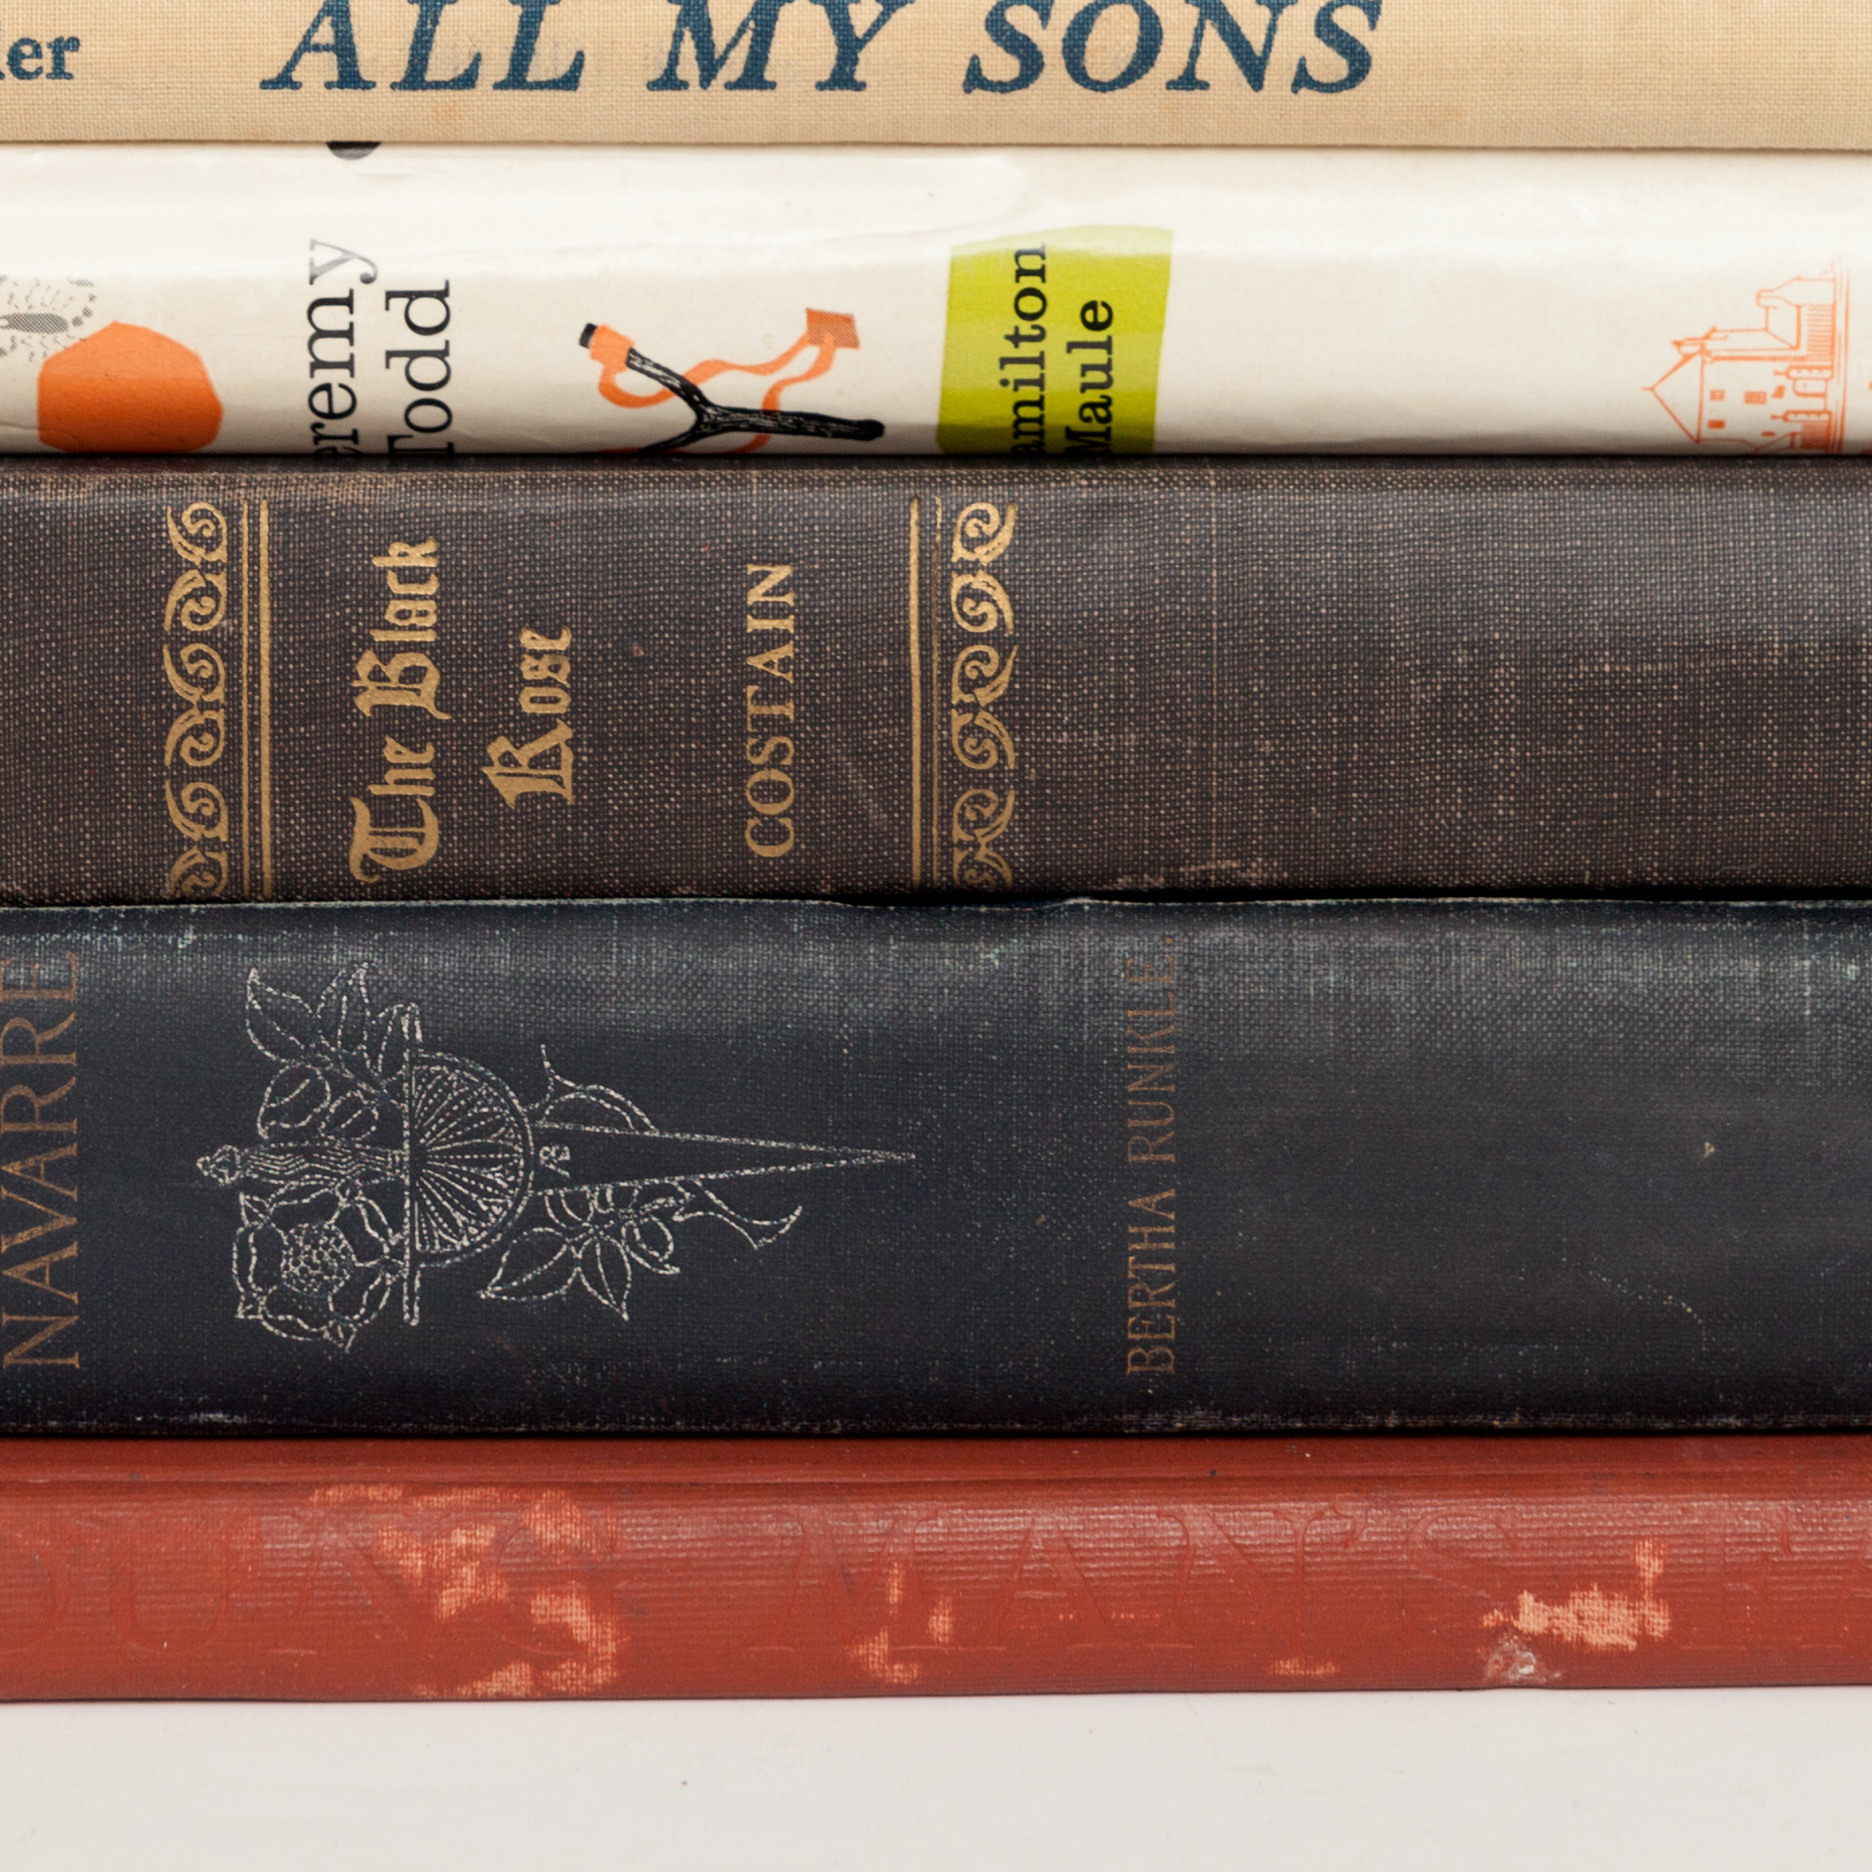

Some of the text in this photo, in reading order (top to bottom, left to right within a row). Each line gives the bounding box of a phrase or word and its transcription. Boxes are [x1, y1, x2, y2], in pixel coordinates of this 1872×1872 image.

[348, 534, 451, 885] The Black
[480, 626, 576, 808] Rose
[746, 562, 797, 860] COSTAIN
[1126, 1187, 1176, 1376] BERTHA
